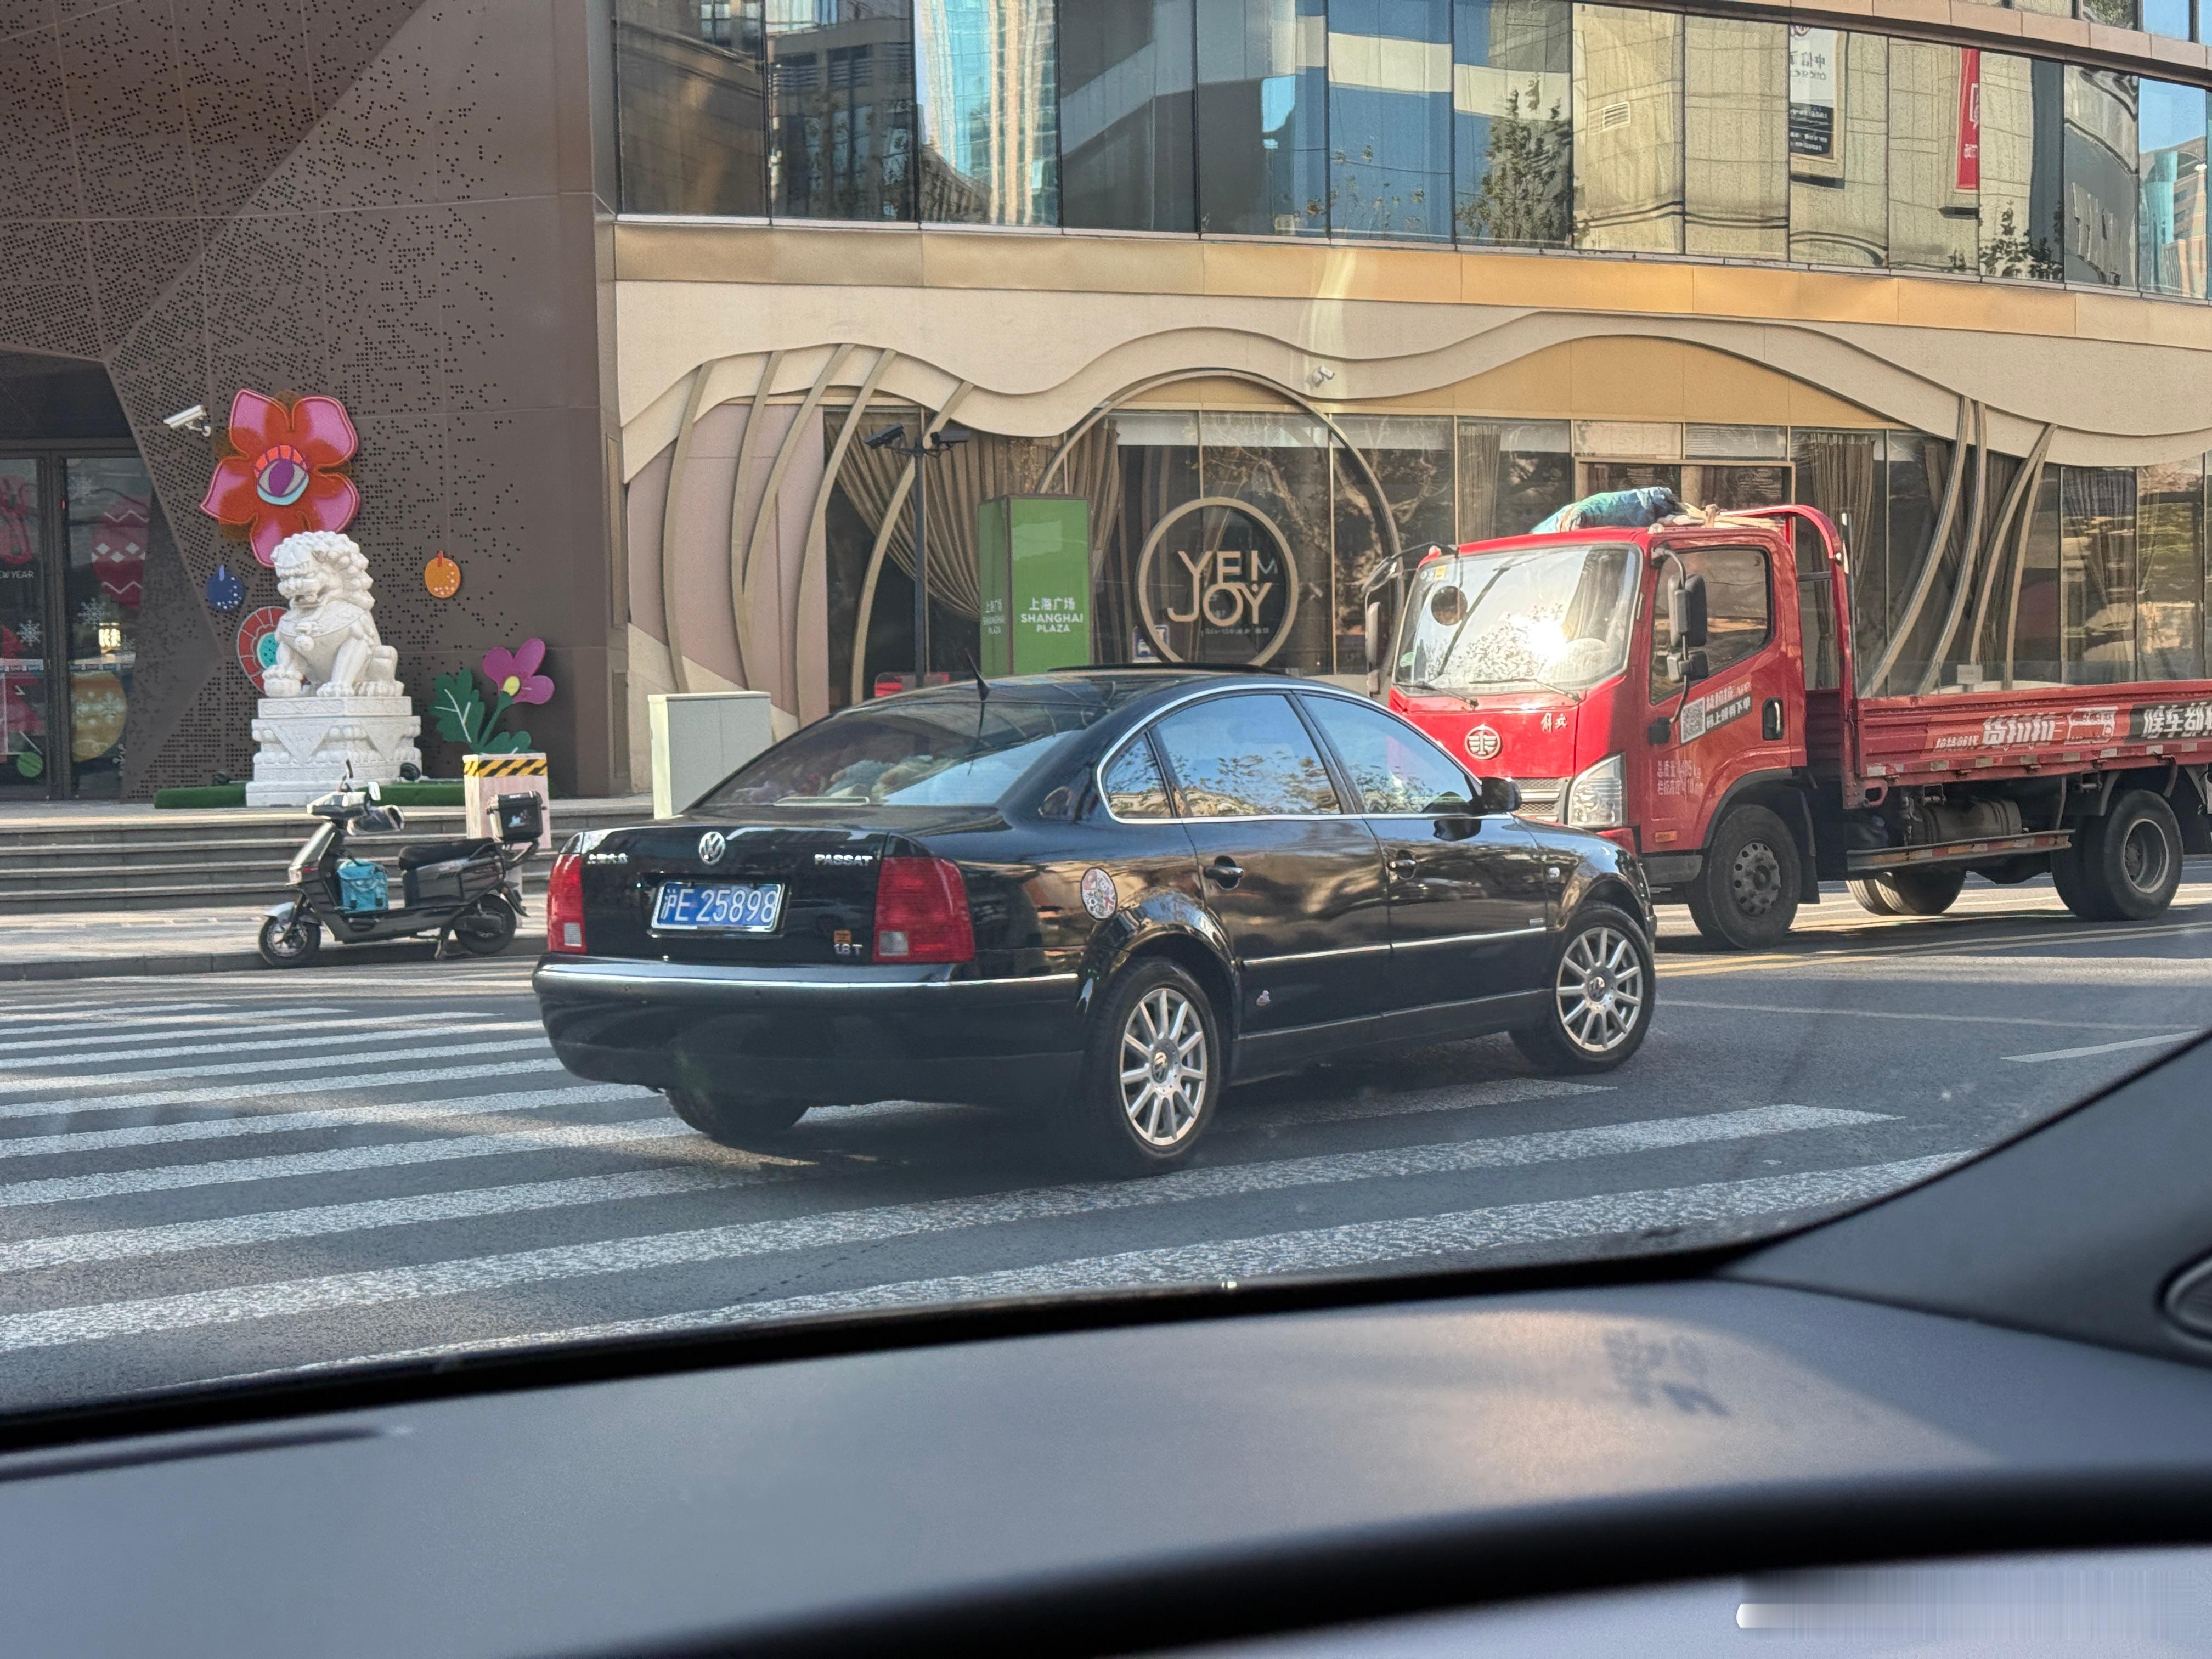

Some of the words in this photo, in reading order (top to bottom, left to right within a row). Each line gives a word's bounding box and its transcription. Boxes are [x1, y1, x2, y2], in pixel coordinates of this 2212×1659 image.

[11, 570, 34, 579] YEAR
[1029, 597, 1075, 611] 上海广场
[1020, 613, 1084, 623] SHANGHAI
[814, 854, 873, 866] PASSAT
